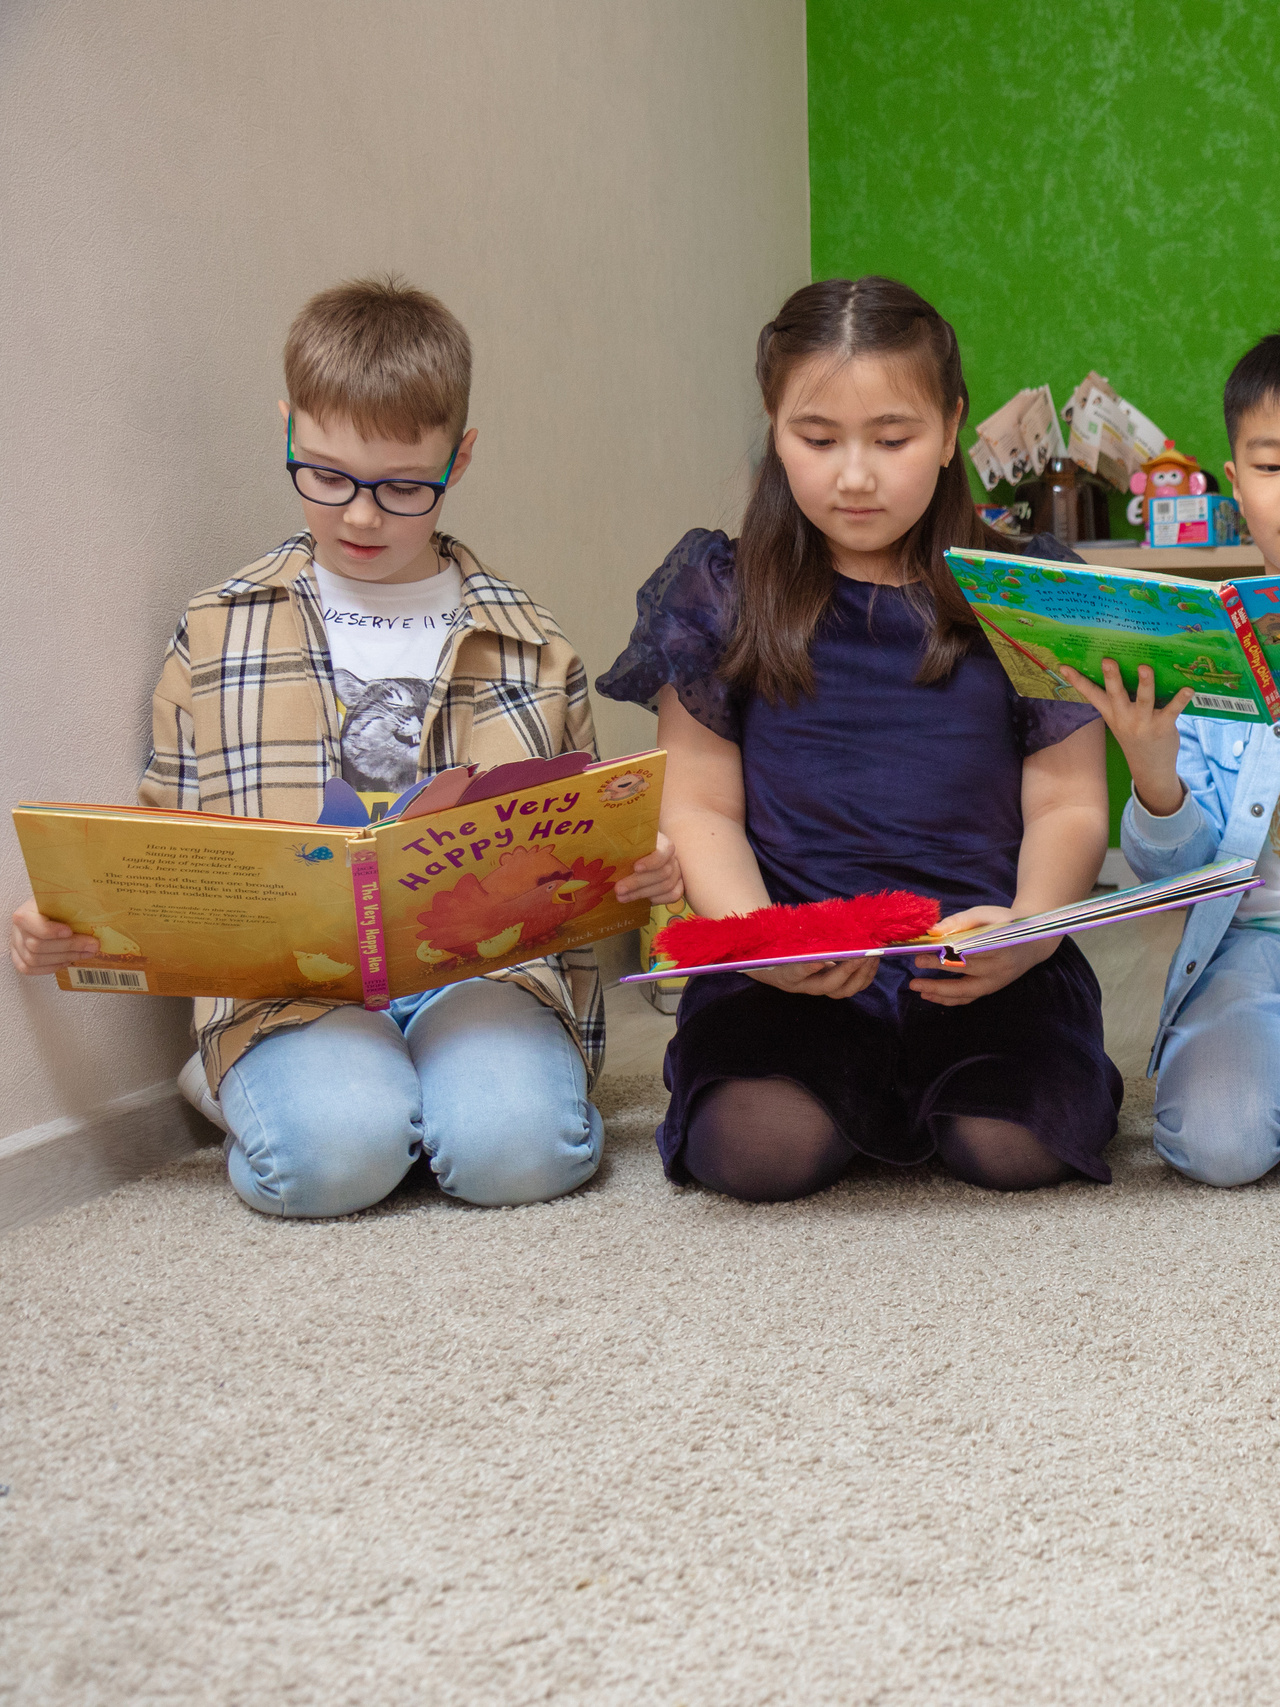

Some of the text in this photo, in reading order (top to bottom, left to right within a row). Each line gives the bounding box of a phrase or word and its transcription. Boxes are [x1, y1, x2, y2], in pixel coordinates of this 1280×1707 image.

[1057, 590, 1087, 598] chirpy
[1057, 598, 1096, 606] walking
[323, 607, 414, 629] DESERVE
[1080, 615, 1112, 624] bright
[1125, 618, 1160, 626] puppies
[1243, 632, 1271, 688] Ten Chirpy Chicks
[597, 769, 653, 793] PEEK-A-BOO
[604, 793, 646, 809] POP-UPS
[402, 792, 581, 857] The Very
[145, 851, 176, 859] Sitting
[204, 848, 235, 856] happy
[398, 819, 595, 891] Happy Hen
[106, 879, 152, 888] flapping,
[155, 883, 202, 891] frolicking
[126, 874, 166, 882] animals
[246, 882, 284, 890] brought
[360, 882, 382, 974] The Very Happy Hen
[564, 917, 636, 946] Jack Tickle
